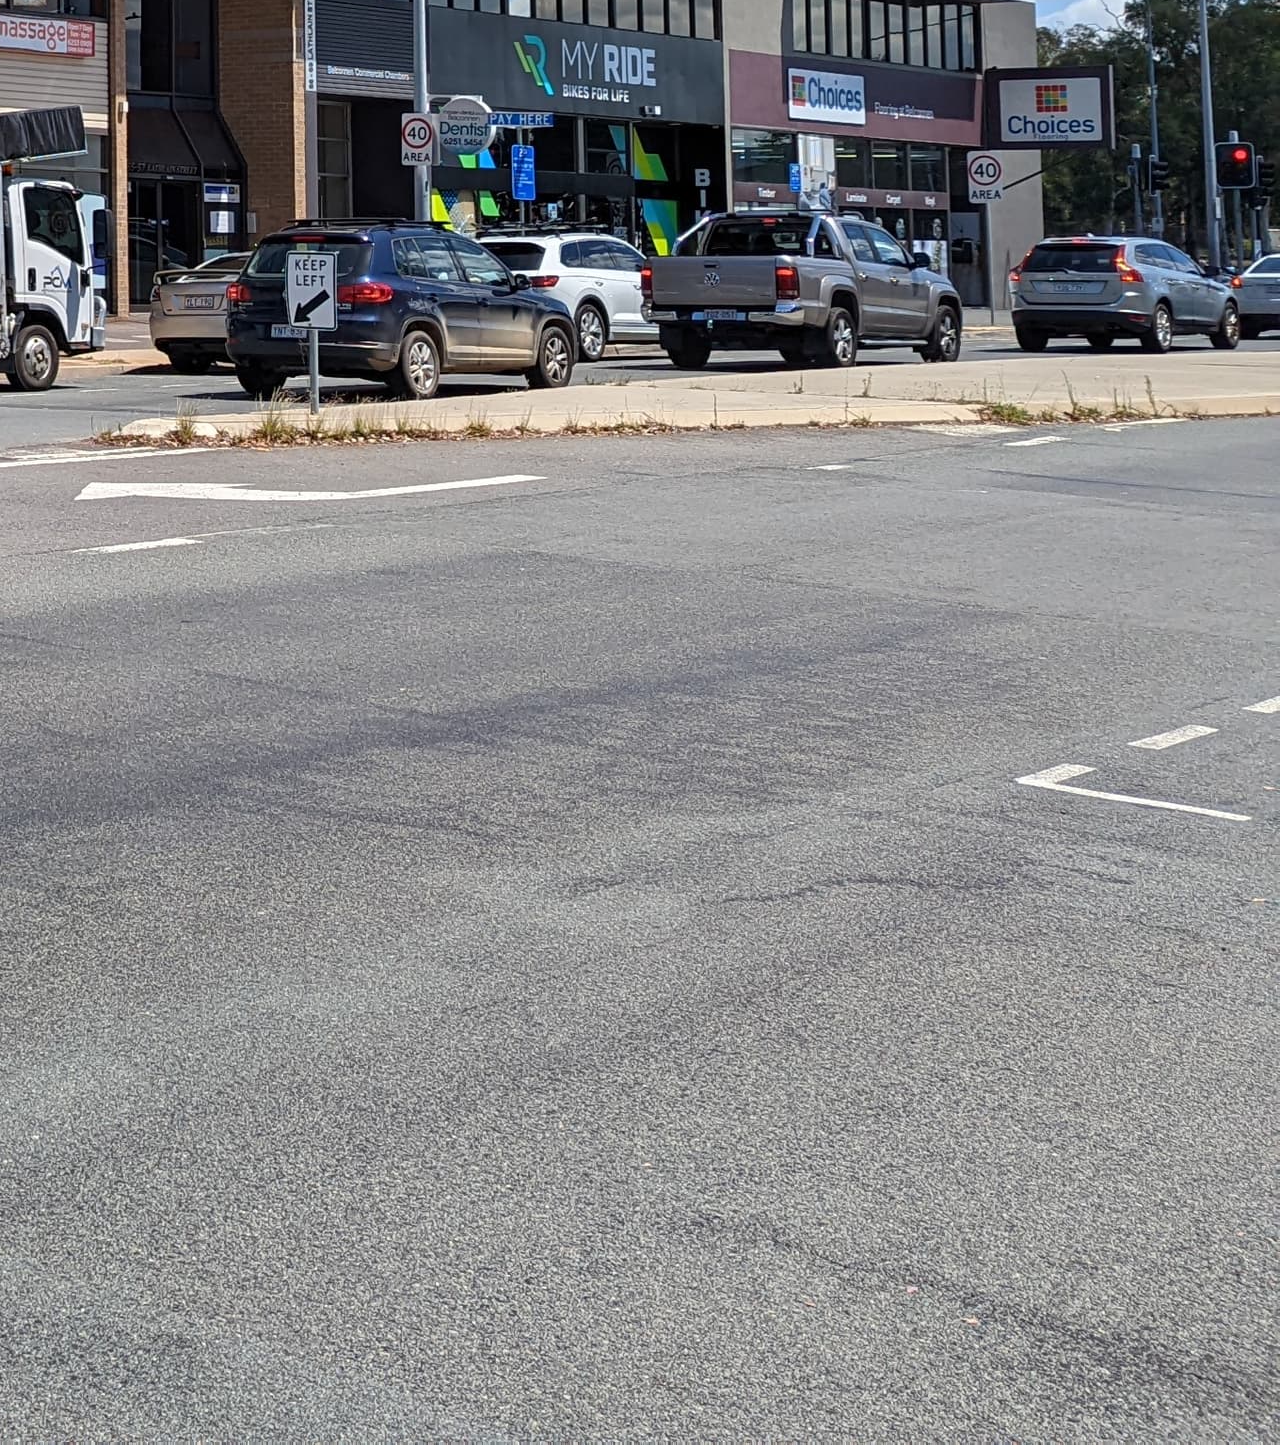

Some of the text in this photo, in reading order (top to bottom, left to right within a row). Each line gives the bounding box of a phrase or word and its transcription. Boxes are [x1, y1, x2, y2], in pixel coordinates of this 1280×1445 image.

[307, 1, 314, 13] ST
[306, 14, 314, 60] LATHLAIN
[561, 38, 657, 87] MY RIDE
[562, 84, 630, 103] BIKES FOR LIFE
[807, 76, 863, 112] Choices
[490, 113, 550, 125] PAY HERE
[1008, 115, 1095, 135] Choices
[407, 126, 427, 141] 40
[440, 122, 490, 136] Dentist
[443, 138, 483, 146] 6251 5454
[403, 153, 431, 162] AREA
[973, 162, 997, 178] 40
[758, 187, 776, 199] Timber
[846, 192, 868, 203] Laminate
[971, 189, 1001, 200] AREA
[886, 194, 901, 206] Carpet
[294, 258, 327, 272] KEEP
[295, 274, 326, 287] LEFT
